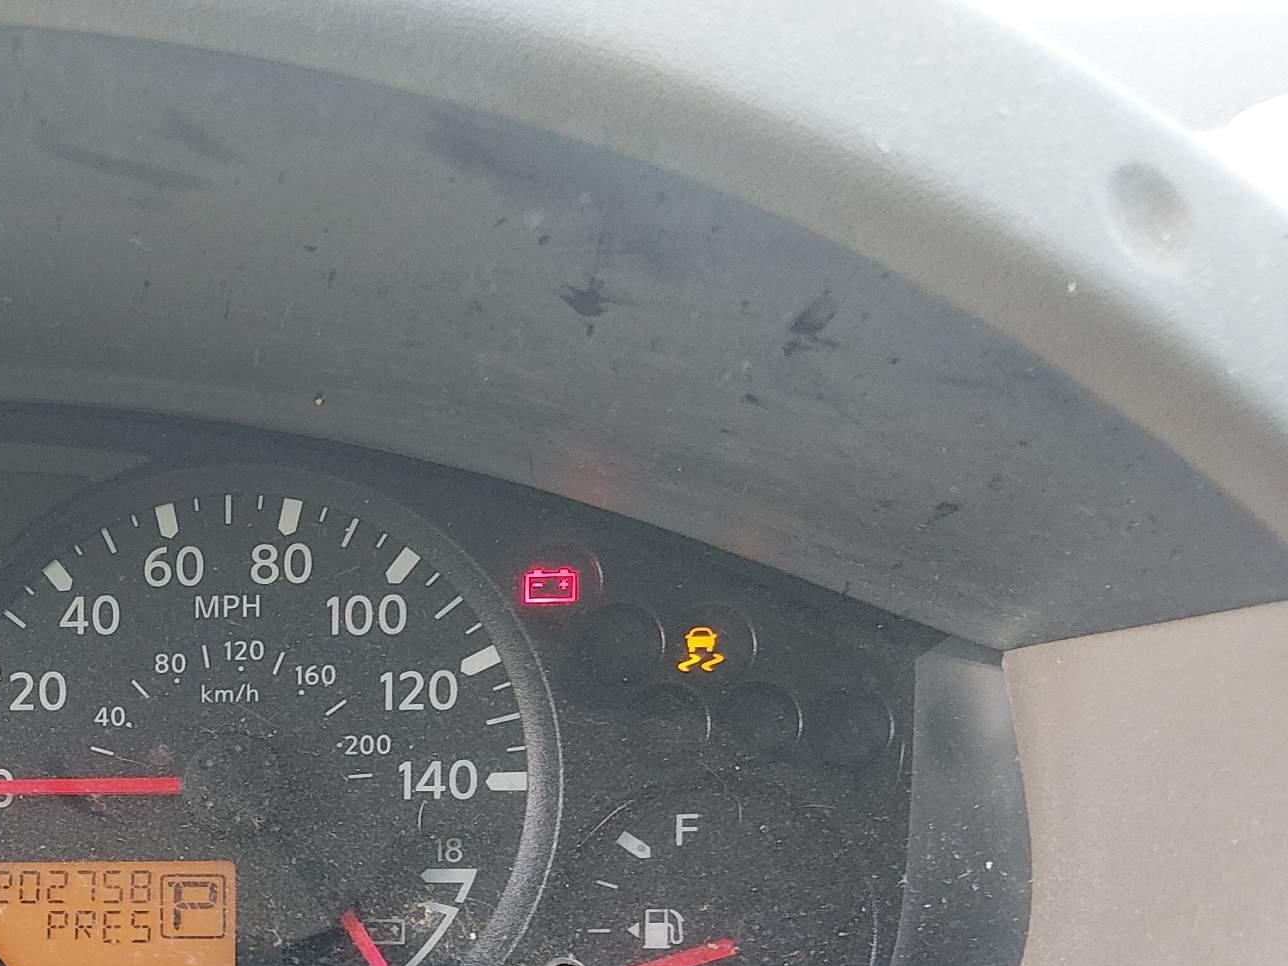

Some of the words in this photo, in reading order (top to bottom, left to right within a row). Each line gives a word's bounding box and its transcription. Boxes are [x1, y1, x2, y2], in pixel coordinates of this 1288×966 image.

[144, 546, 204, 587] 60
[251, 543, 312, 585] 80
[60, 595, 120, 635] 40
[195, 595, 261, 618] MPH
[327, 594, 407, 635] 100
[155, 653, 185, 674] 80
[224, 641, 264, 661] 120
[9, 671, 67, 712] 20
[296, 665, 336, 686] 160
[381, 671, 458, 711] 120
[201, 683, 259, 704] km/h
[94, 706, 125, 727] 40
[345, 735, 392, 756] 200
[398, 760, 478, 800] 140
[676, 813, 699, 846] F
[435, 838, 462, 863] 18
[169, 881, 218, 931] P
[47, 911, 152, 943] PRES
